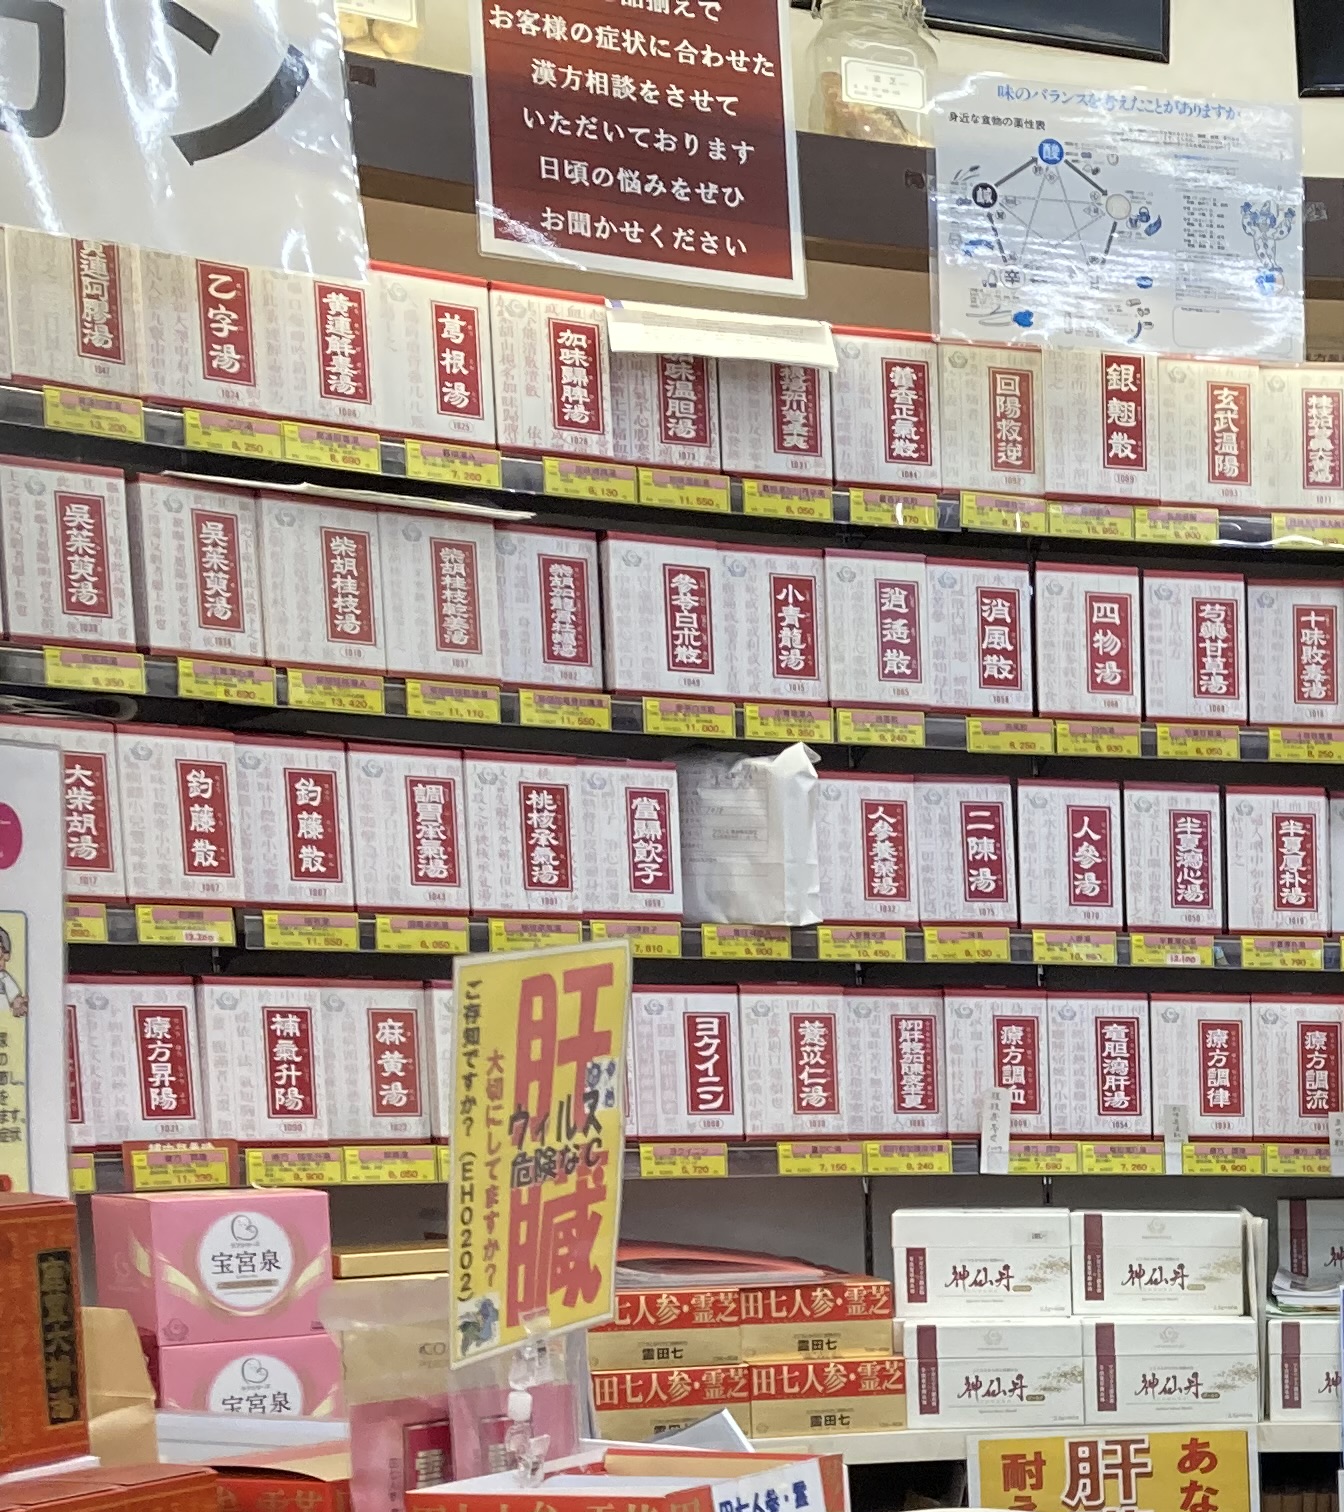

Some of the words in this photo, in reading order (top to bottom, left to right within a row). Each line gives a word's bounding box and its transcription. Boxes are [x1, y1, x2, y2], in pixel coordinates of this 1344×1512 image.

[489, 7, 775, 77] お客様の症状に合わせた
[531, 59, 739, 117] 漢方相談をさせて
[524, 107, 755, 165] いただいております
[540, 156, 745, 208] 日頃の悩みをぜひ
[541, 207, 747, 256] お聞かせください
[207, 271, 241, 373] 乙字湯
[438, 313, 471, 409] 葛根湯
[332, 535, 361, 635] 柴胡桂枝湯
[777, 583, 806, 672] 小青龍湯
[981, 598, 1014, 681] 消風散
[1092, 602, 1122, 685] 四物湯
[65, 764, 98, 860] 大柴胡湯
[967, 811, 998, 892] 二陳湯
[377, 1019, 408, 1108] 麻黄湯
[694, 1018, 725, 1111] ヨクイニン
[211, 1249, 282, 1276] 宝宮泉
[945, 1263, 1015, 1292] 神仙丹
[1121, 1263, 1189, 1291] 神仙丹
[740, 1284, 891, 1320] 田七人参・霊芝
[595, 1367, 749, 1406] 田七人参・霊芝
[753, 1361, 904, 1396] 田七人参・霊芝
[956, 1373, 1028, 1404] 神仙丹
[1134, 1371, 1204, 1404] 神仙丹
